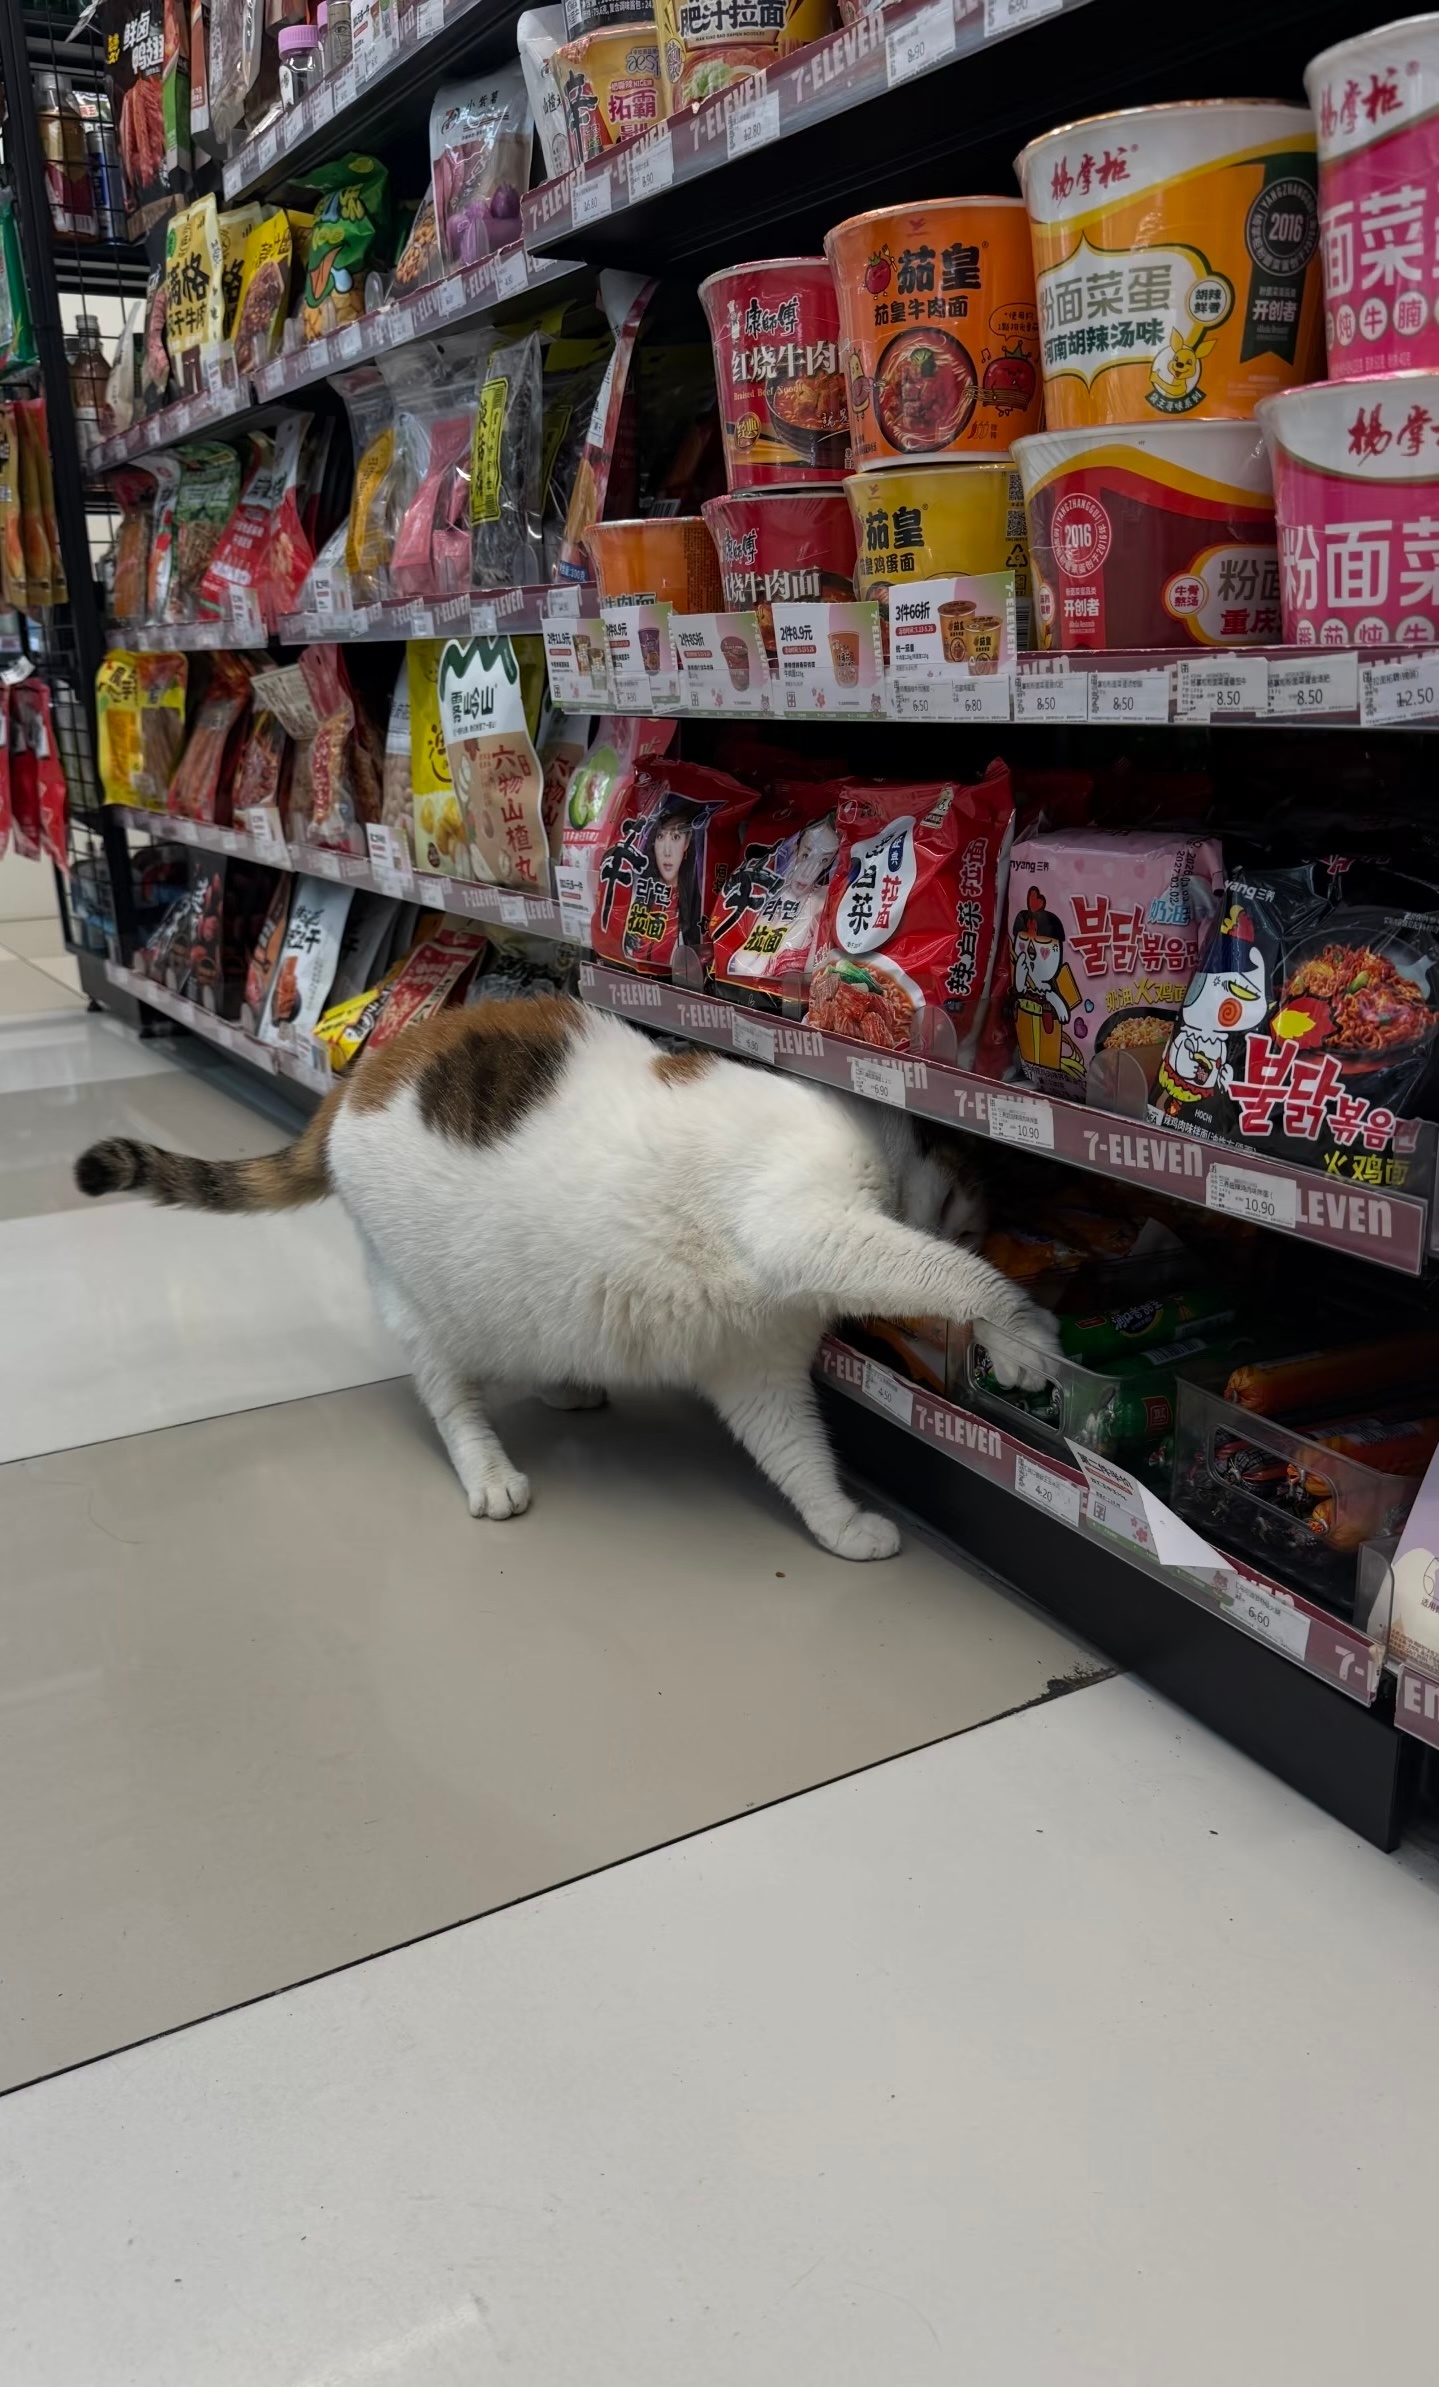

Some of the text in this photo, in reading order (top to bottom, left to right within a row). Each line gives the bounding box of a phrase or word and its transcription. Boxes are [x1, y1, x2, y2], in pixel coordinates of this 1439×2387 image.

[1050, 147, 1132, 208] 杨掌柜
[1268, 212, 1304, 242] 2016
[897, 242, 982, 295] 茄皇
[874, 296, 968, 326] 茄皇牛肉面
[1252, 299, 1298, 323] 开创者
[1347, 403, 1439, 468] 杨掌
[866, 506, 925, 551] 茄皇
[1064, 523, 1092, 548] 2016
[895, 601, 930, 622] 3件66折
[1063, 597, 1100, 618] 开创者
[1220, 607, 1282, 636] 重庆
[780, 625, 813, 642] 2件8.9元
[964, 699, 982, 712] 6.80
[1037, 697, 1056, 711] 8.50
[1113, 696, 1134, 711] 8.50
[1216, 690, 1241, 706] 8.50
[1297, 688, 1324, 706] 8.50
[1396, 686, 1434, 708] 12.50
[491, 744, 537, 883] 六物山楂丸
[871, 874, 902, 929] 拉面
[946, 837, 989, 996] 辣白菜拉面
[1017, 1124, 1040, 1140] 10.90
[1322, 1149, 1414, 1188] 火鸡面
[1244, 1197, 1276, 1217] 10.90
[1248, 1605, 1271, 1628] 6.60
